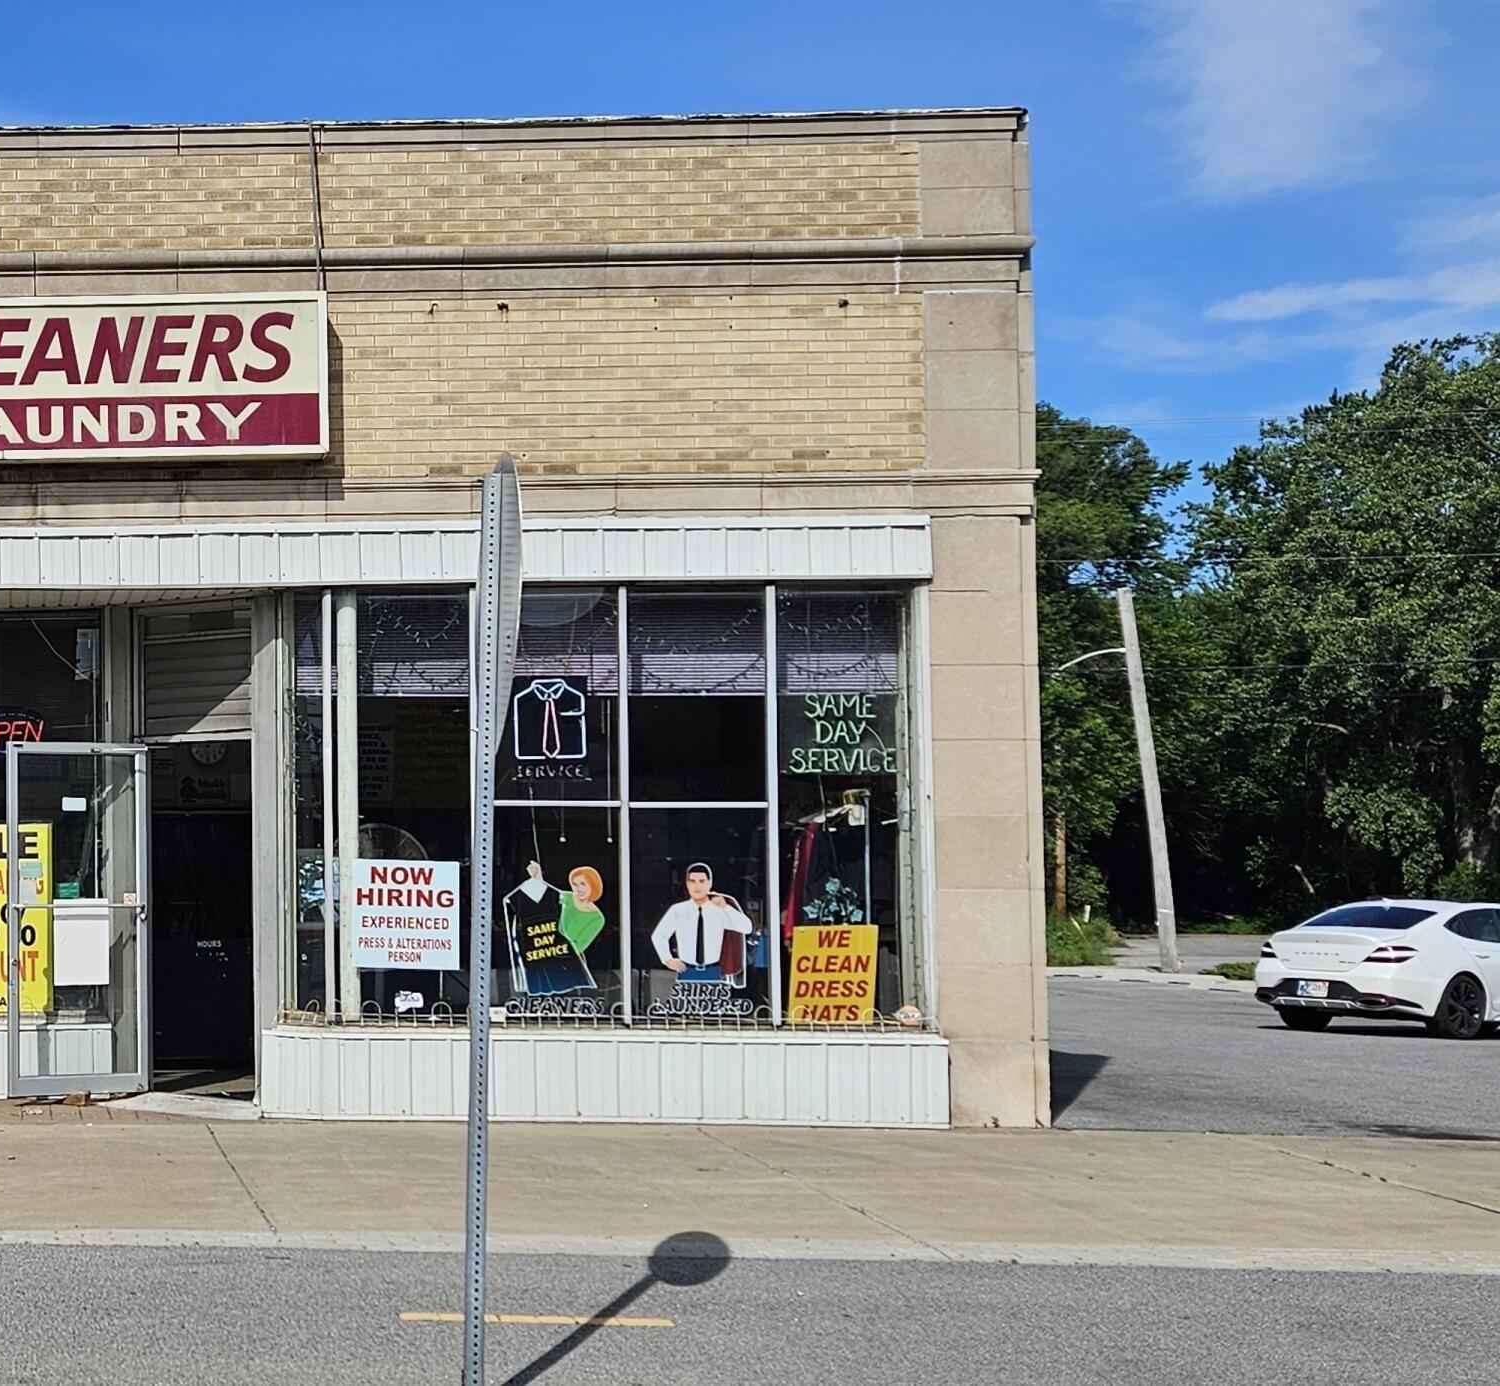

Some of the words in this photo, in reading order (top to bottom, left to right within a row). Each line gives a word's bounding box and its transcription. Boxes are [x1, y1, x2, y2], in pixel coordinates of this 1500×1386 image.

[804, 692, 877, 718] SAME
[814, 720, 866, 744] DAY
[789, 748, 897, 773] SERVICE
[517, 764, 584, 778] SERVICE
[370, 866, 434, 885] NOW
[356, 888, 455, 908] HIRING
[361, 915, 450, 930] EXPERIENCED
[526, 921, 557, 937] SAME
[358, 937, 385, 949] PRESS
[387, 937, 394, 949] &
[396, 938, 452, 951] ALTERATIONS
[533, 933, 556, 948] DAY
[818, 930, 852, 948] WE
[388, 951, 422, 963] PERSON
[525, 943, 570, 962] SERVICE
[796, 955, 871, 973] CLEAN
[669, 983, 732, 999] SHIRTS
[794, 980, 869, 998] DRESS
[506, 996, 604, 1016] CLEANERS
[650, 998, 754, 1015] LAUNDERED
[801, 1004, 860, 1022] HATS
